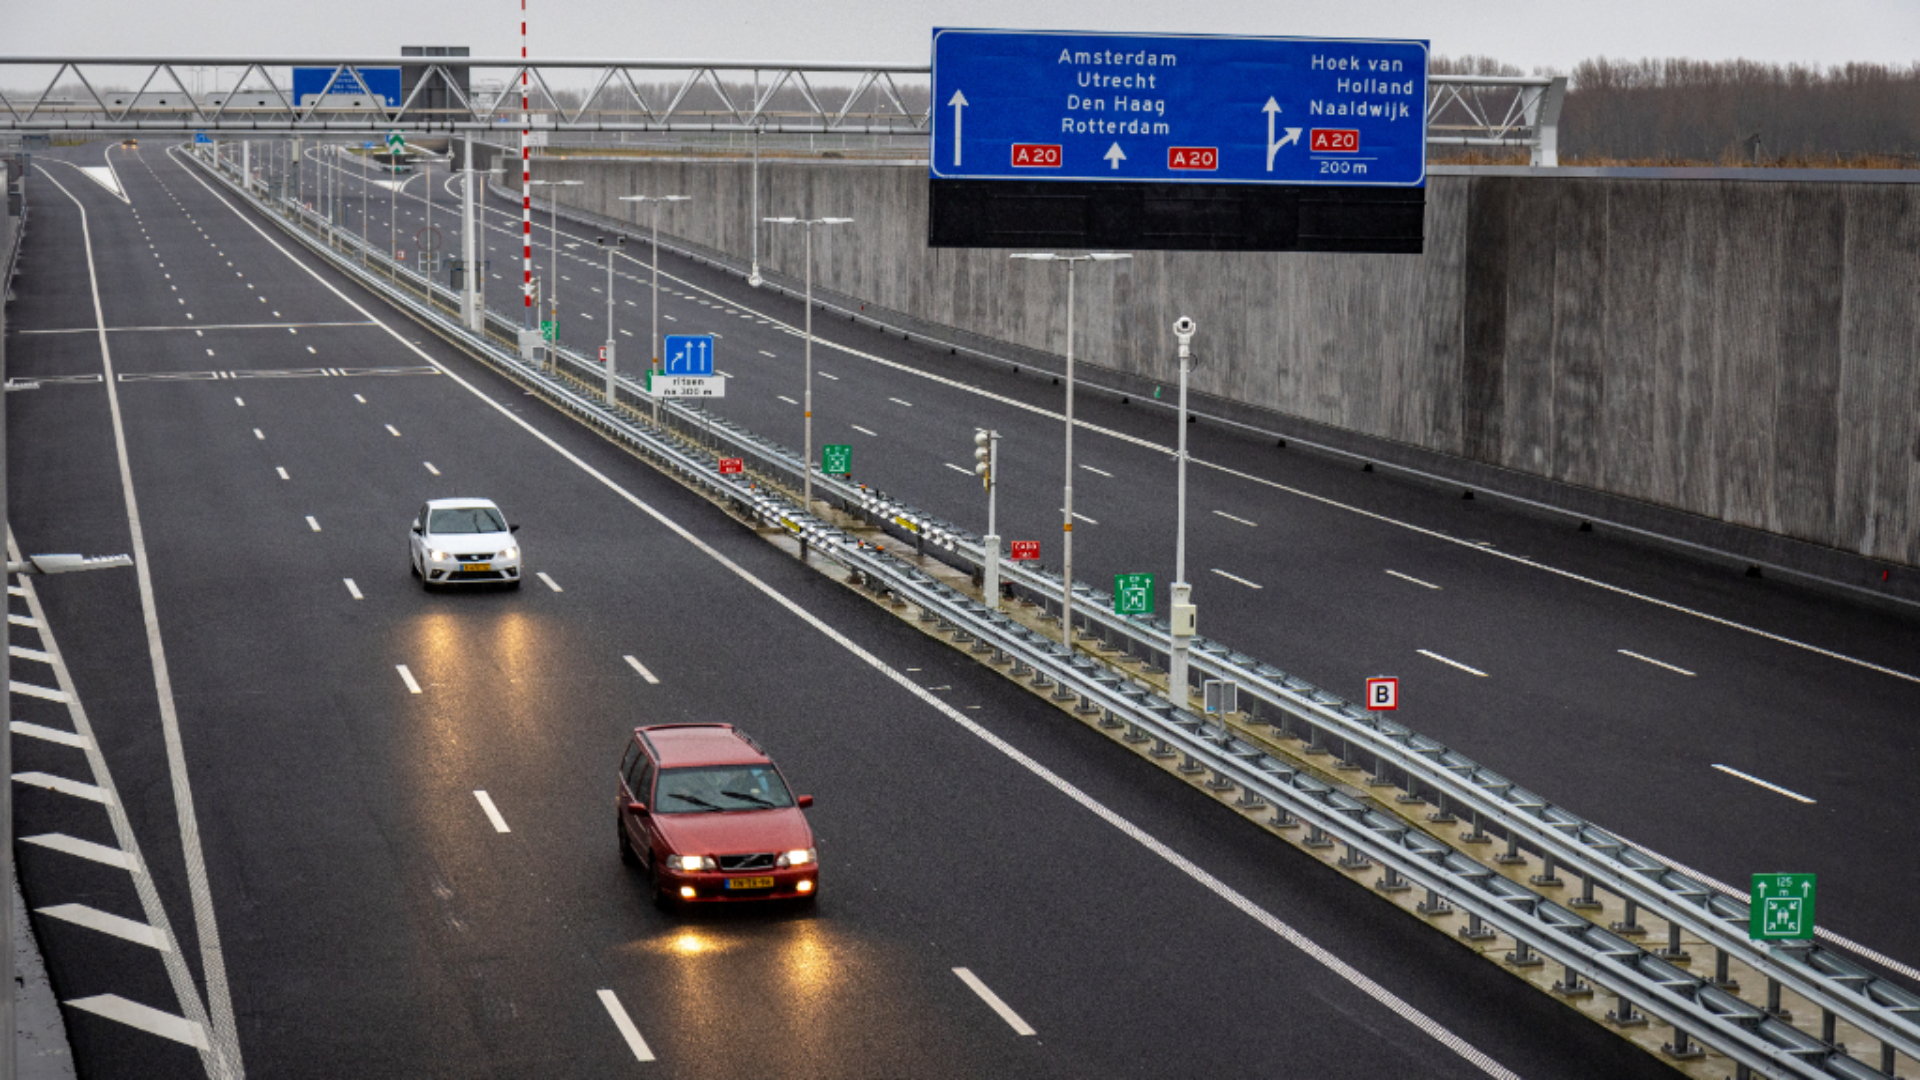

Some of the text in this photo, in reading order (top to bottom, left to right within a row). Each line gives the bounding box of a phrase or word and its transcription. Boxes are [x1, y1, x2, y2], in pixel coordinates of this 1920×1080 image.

[1058, 48, 1177, 66] Amsterdam
[1311, 54, 1403, 72] Hoek van
[1078, 71, 1156, 89] Utrecht
[1337, 78, 1414, 95] Holland
[1067, 94, 1165, 117] Den Haag
[1310, 99, 1410, 122] Naaldwijk
[1062, 118, 1170, 135] Rotterdam
[1375, 685, 1389, 703] B
[1777, 876, 1793, 887] 125
